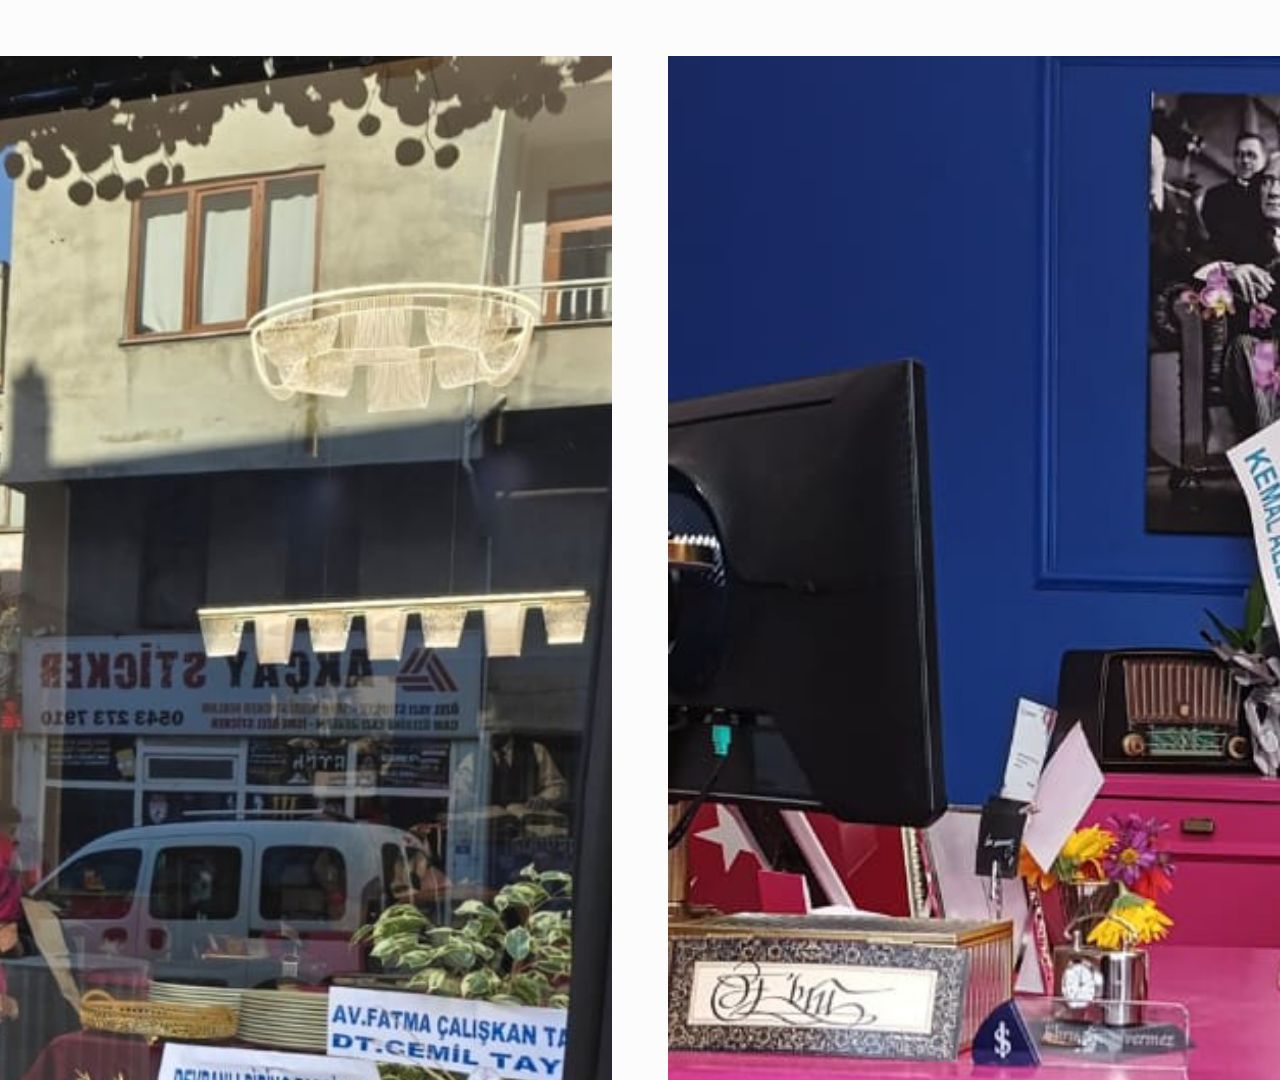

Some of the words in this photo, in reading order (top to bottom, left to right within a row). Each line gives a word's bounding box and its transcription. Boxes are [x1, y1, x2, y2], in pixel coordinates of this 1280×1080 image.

[332, 1004, 431, 1033] AV.FATMA
[437, 1014, 536, 1046] ÇALIŞKAN
[332, 1033, 478, 1066] DT.CEMİL
